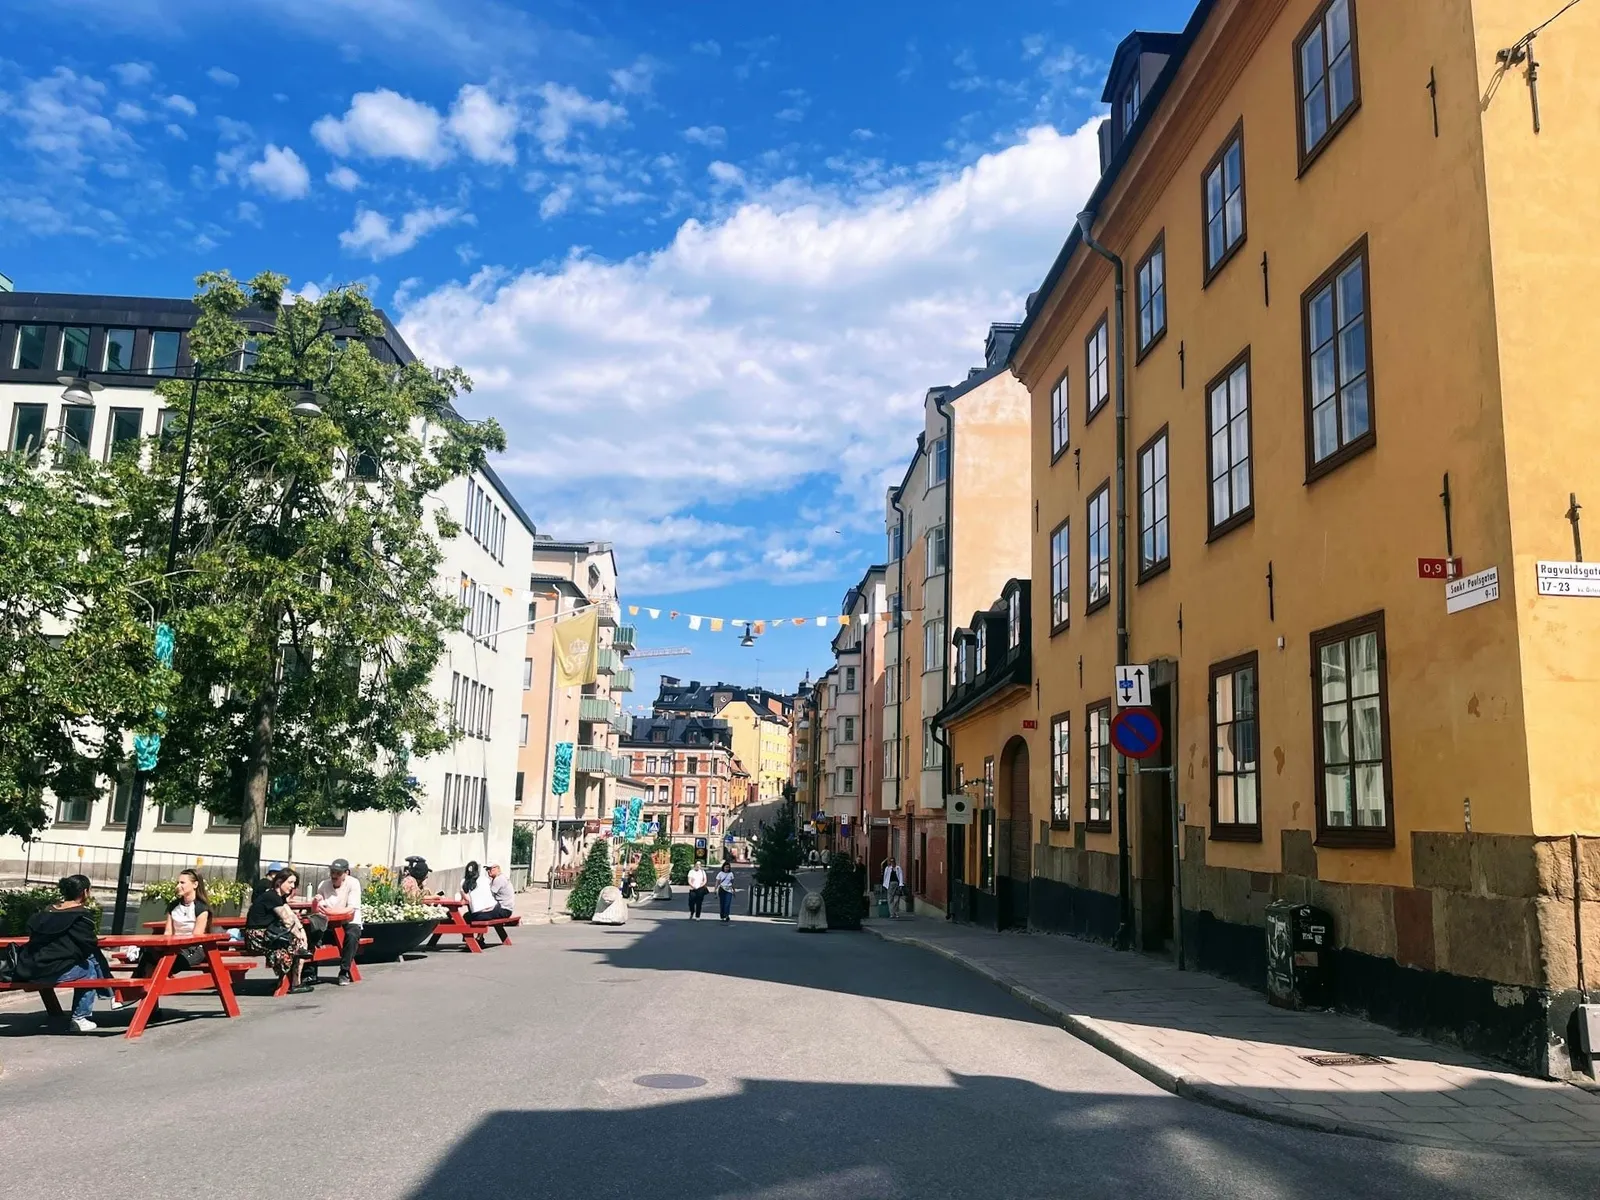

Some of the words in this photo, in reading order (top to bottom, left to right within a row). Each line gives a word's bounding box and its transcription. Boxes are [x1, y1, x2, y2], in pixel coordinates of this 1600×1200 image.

[1423, 563, 1442, 575] 0,9
[1450, 581, 1465, 594] Sankt
[1467, 572, 1496, 588] Paulsgatan
